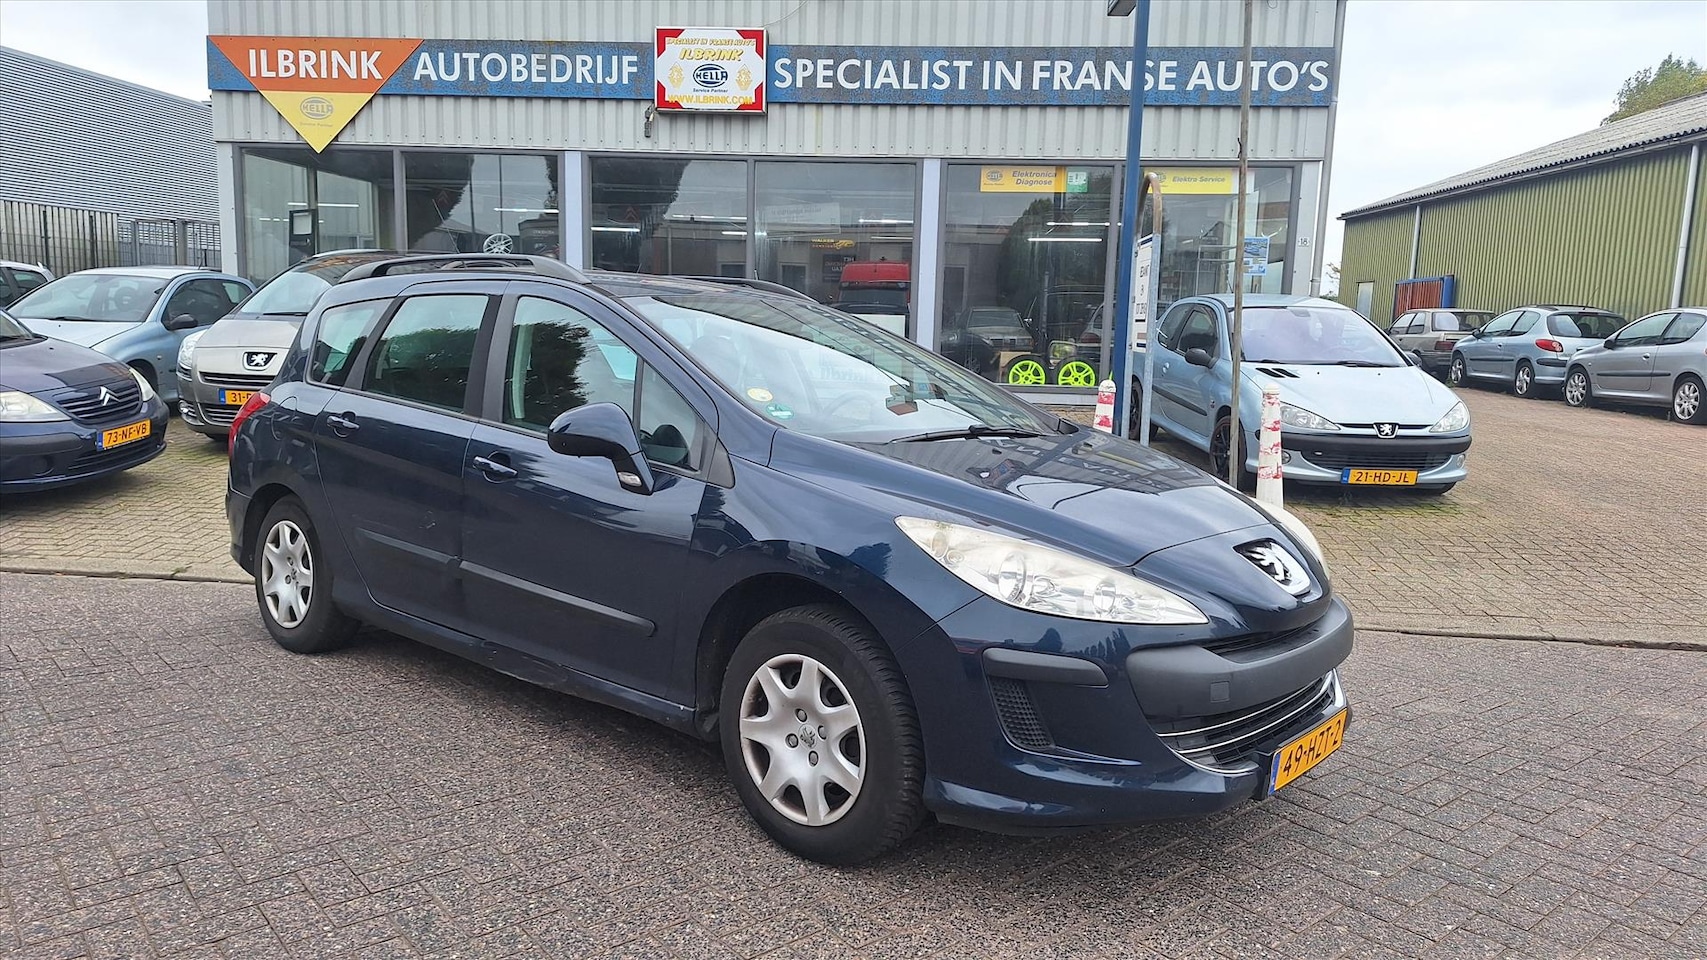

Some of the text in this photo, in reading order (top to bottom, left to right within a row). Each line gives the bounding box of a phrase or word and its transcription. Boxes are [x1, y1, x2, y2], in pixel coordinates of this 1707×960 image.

[679, 48, 744, 62] ILBRINK
[249, 49, 384, 81] ILBRINK
[413, 51, 638, 85] AUTOBEDRIJF
[774, 57, 1328, 92] SPECIALIST IN FRANSE AUTO'S
[668, 95, 753, 105] WWW.ILBRINK.COM
[1012, 171, 1057, 179] Elektronica
[1016, 179, 1052, 187] Diagnose
[106, 423, 147, 444] 73-NF-VB
[1355, 471, 1410, 483] 21-HD-JL
[1283, 719, 1341, 777] 49-HZT-2
